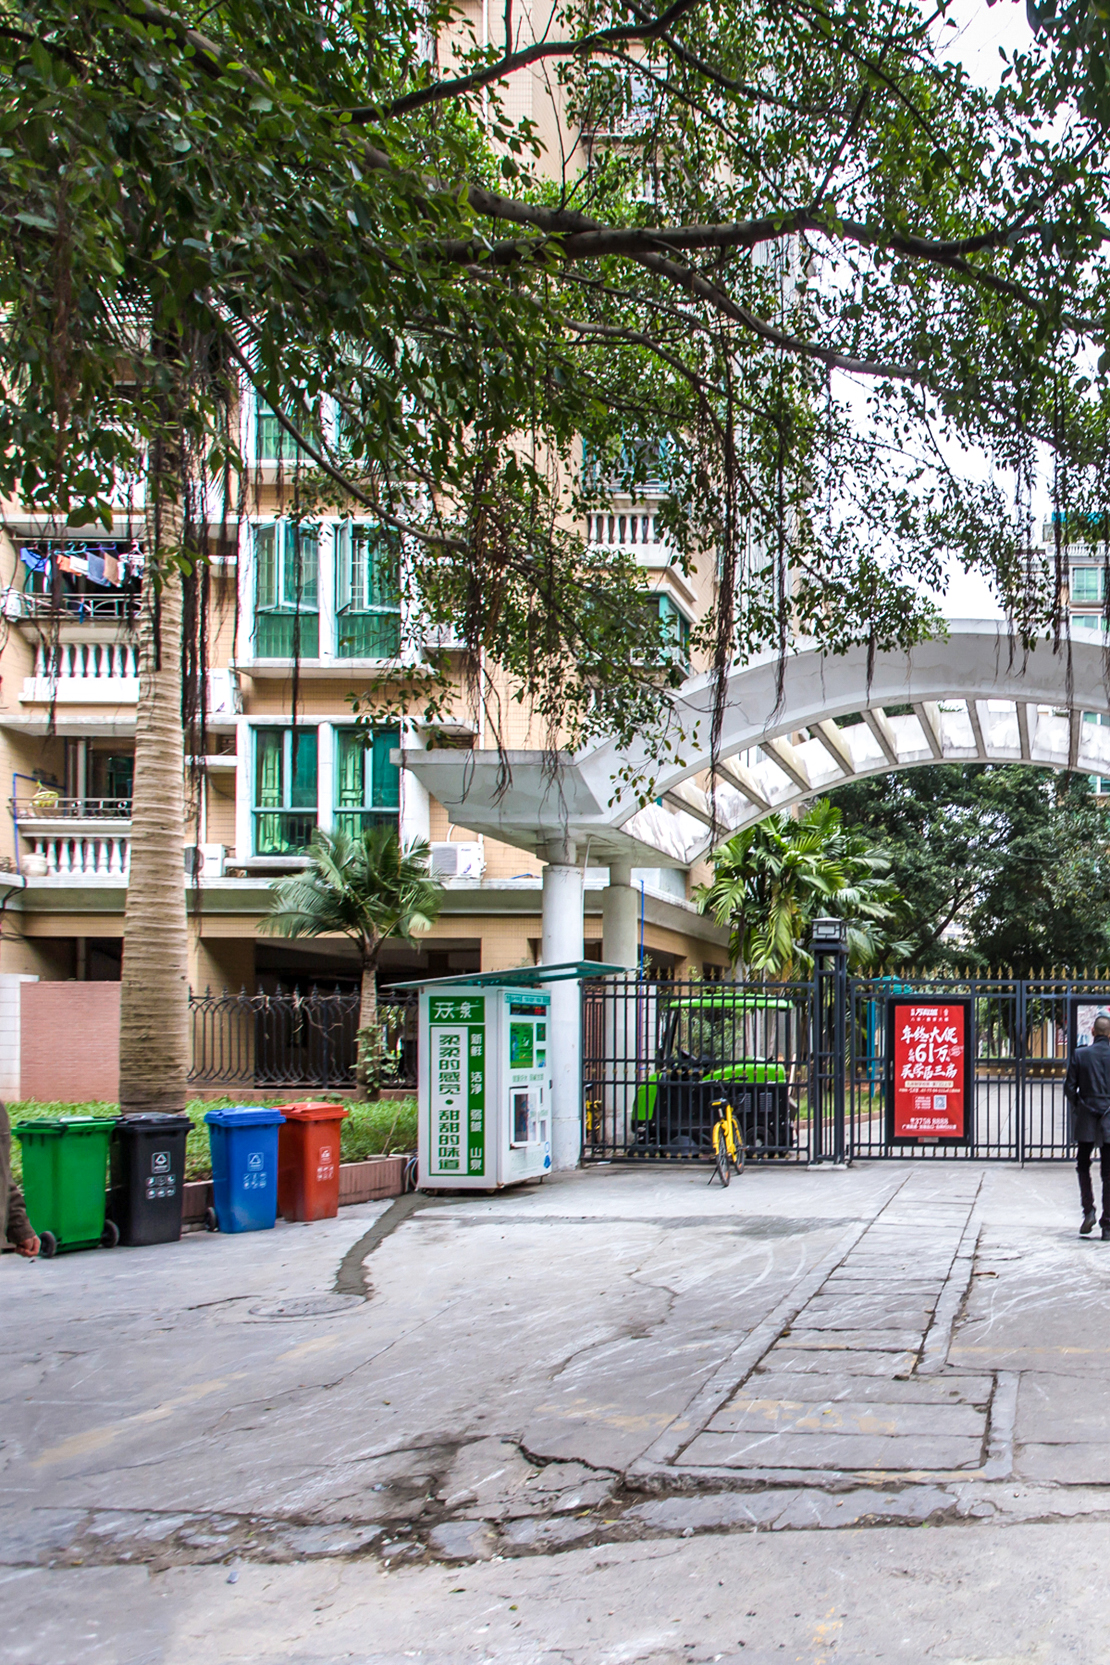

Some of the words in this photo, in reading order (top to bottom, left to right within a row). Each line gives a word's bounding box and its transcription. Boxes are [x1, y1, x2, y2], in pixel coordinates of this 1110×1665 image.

[470, 1033, 483, 1056] 新鲜
[900, 1025, 958, 1044] 年终大促
[470, 1071, 483, 1095] 洁净
[470, 1147, 483, 1170] 山泉
